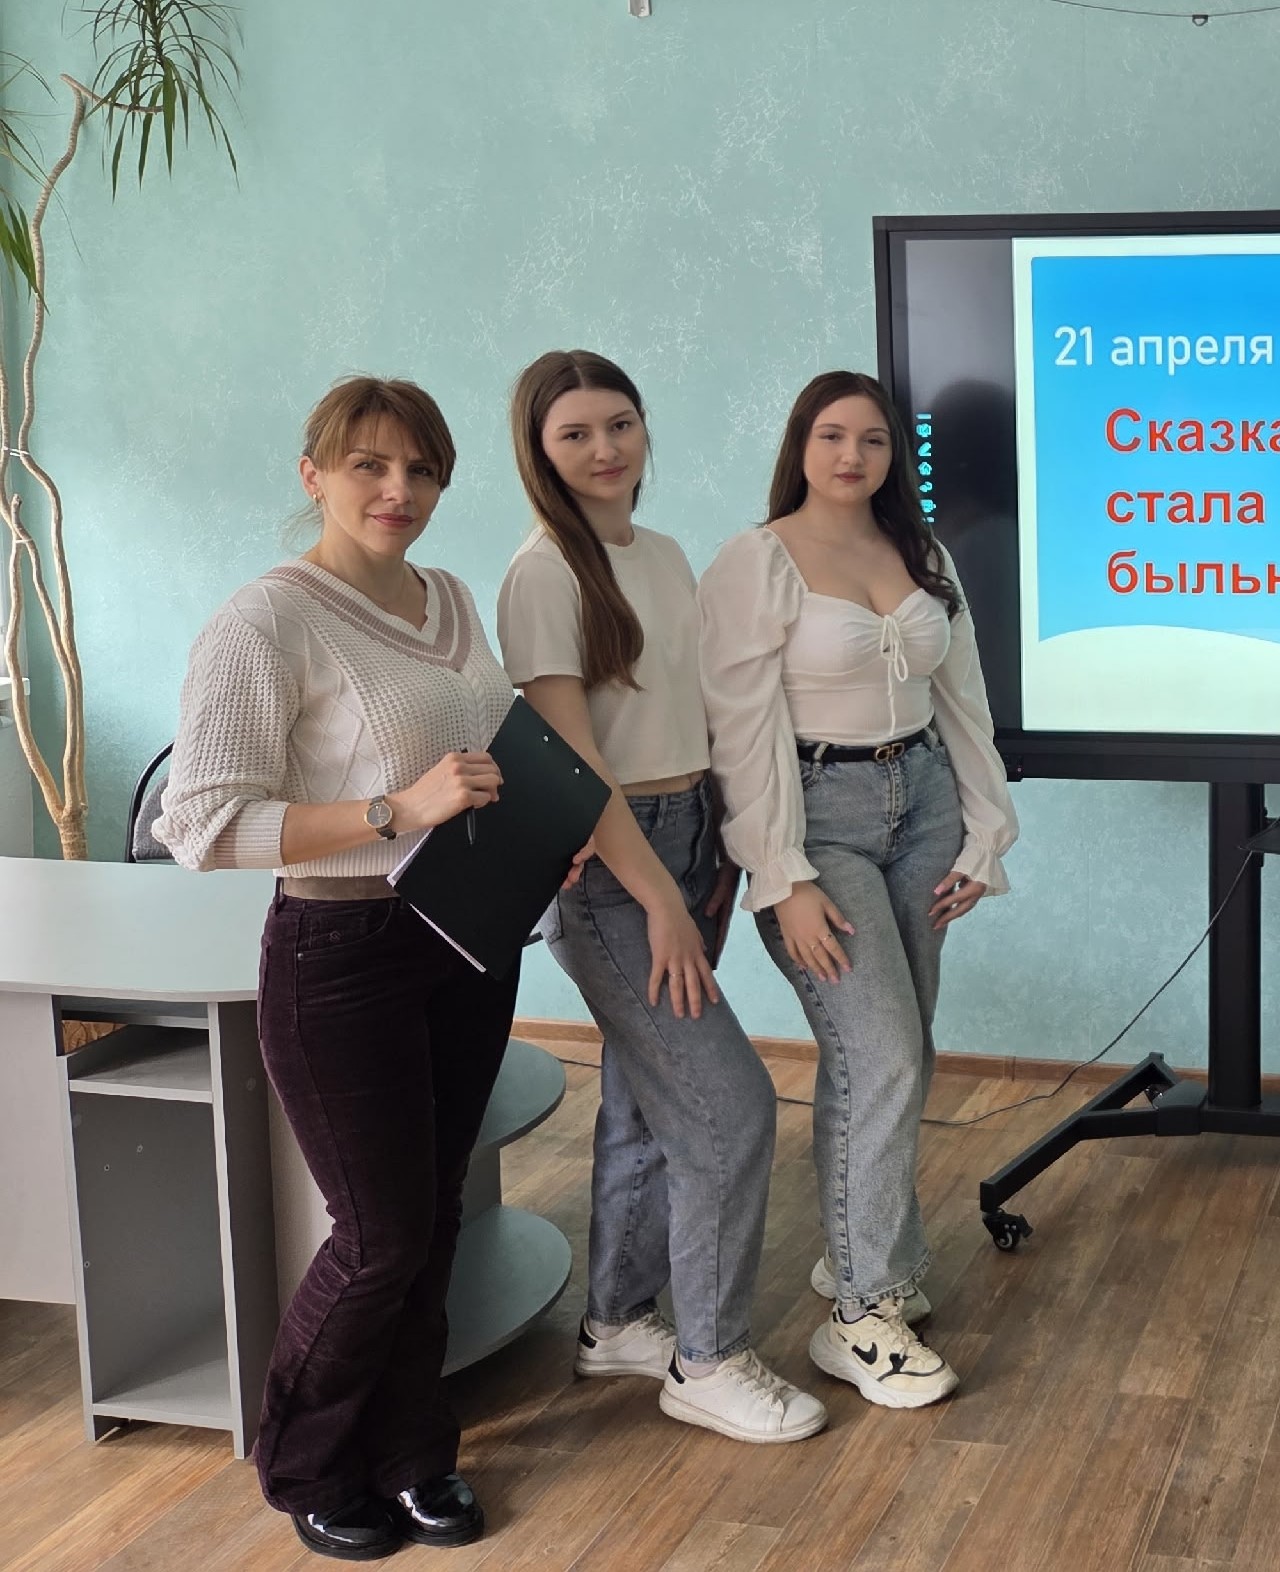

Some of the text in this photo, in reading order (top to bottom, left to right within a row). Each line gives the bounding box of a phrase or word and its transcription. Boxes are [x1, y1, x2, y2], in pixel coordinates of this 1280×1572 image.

[1054, 326, 1093, 366] 21
[1111, 334, 1273, 376] апреля
[1106, 490, 1265, 524] стала
